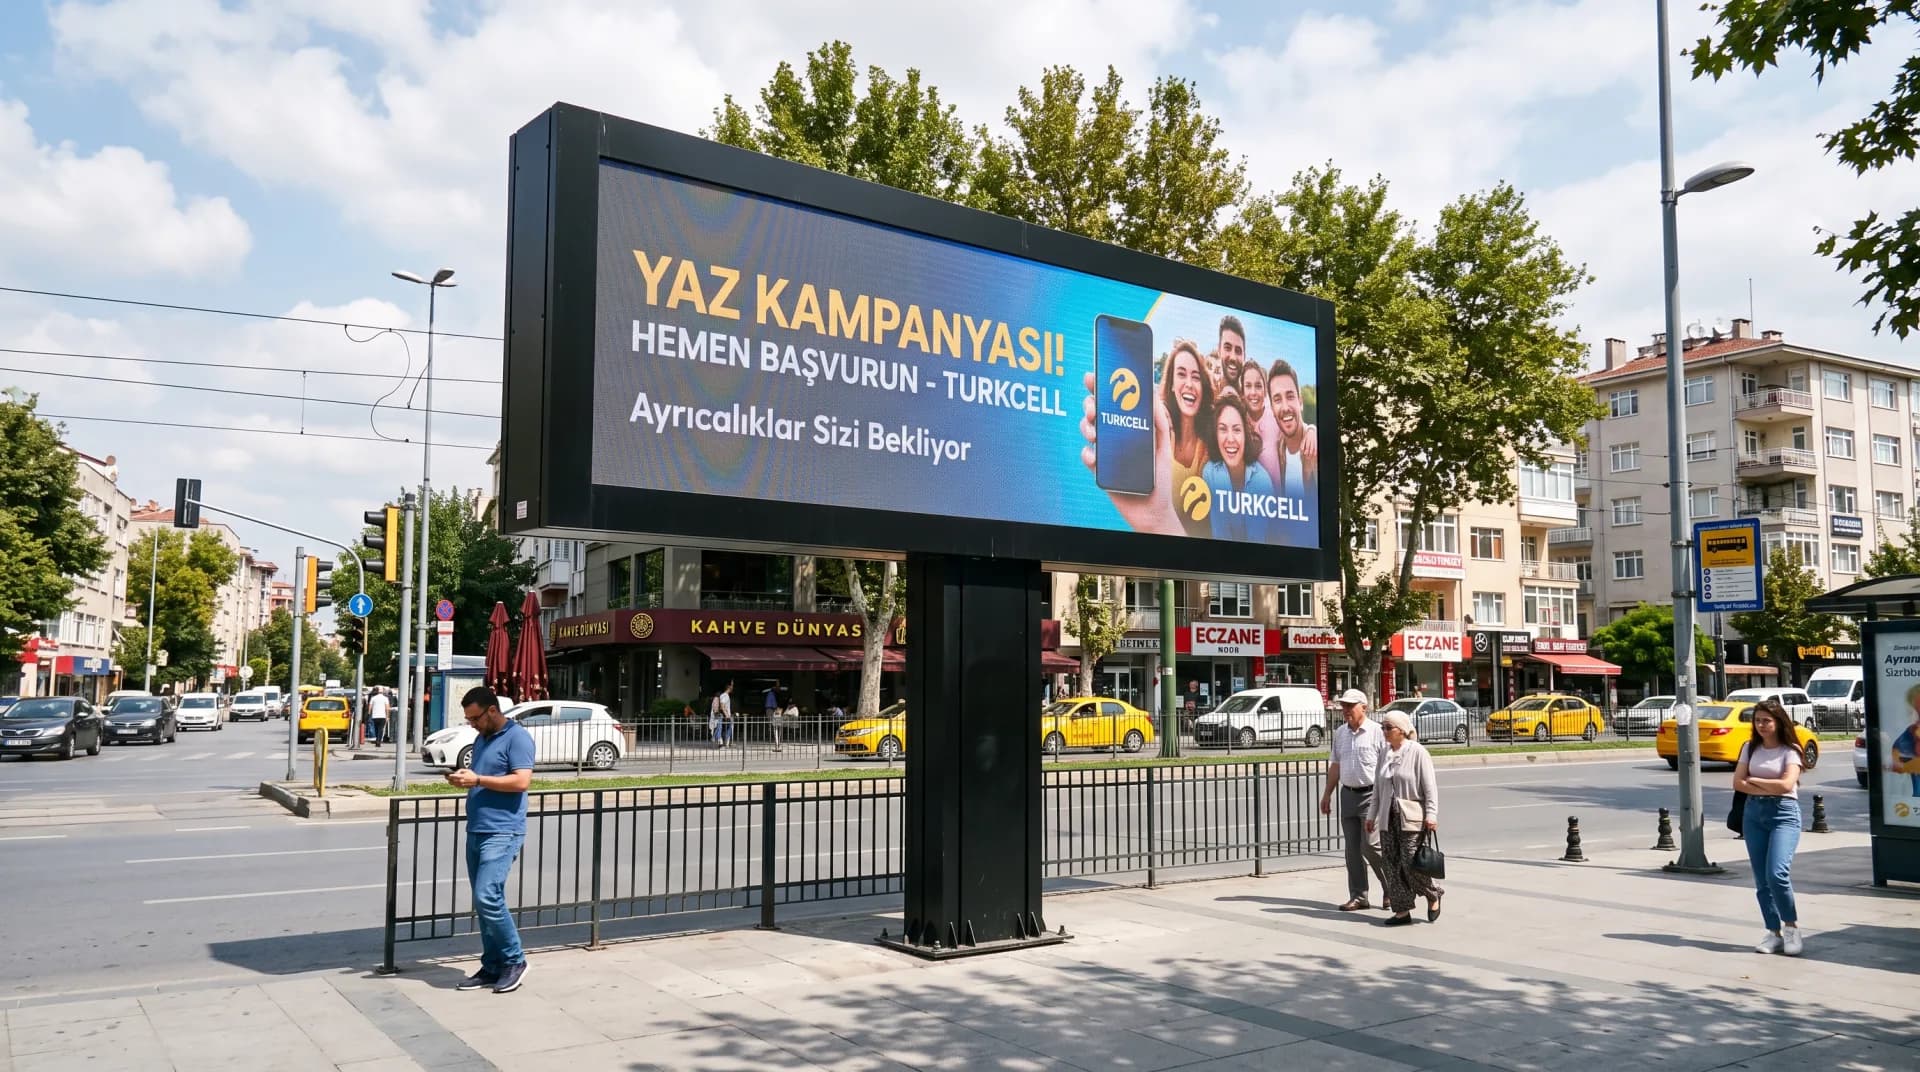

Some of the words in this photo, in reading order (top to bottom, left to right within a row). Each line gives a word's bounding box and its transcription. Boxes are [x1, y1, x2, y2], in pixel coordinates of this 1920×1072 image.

[633, 249, 740, 320] YAZ
[756, 274, 1065, 376] KAMPANYASI!
[632, 319, 750, 369] HEMEN
[760, 341, 918, 394] BAŞVURUN
[943, 370, 1067, 417] TURKCELL
[629, 391, 806, 442] Ayrıcalıklar
[813, 414, 860, 448] Sizi
[868, 422, 972, 466] Bekliyor
[1101, 411, 1150, 431] TURKCELL
[1215, 489, 1309, 522] TURKCELL
[691, 619, 766, 635] KAHVE
[777, 618, 863, 637] DÜNYAS
[1196, 627, 1261, 645] ECZANE
[1407, 635, 1459, 651] ECZANE
